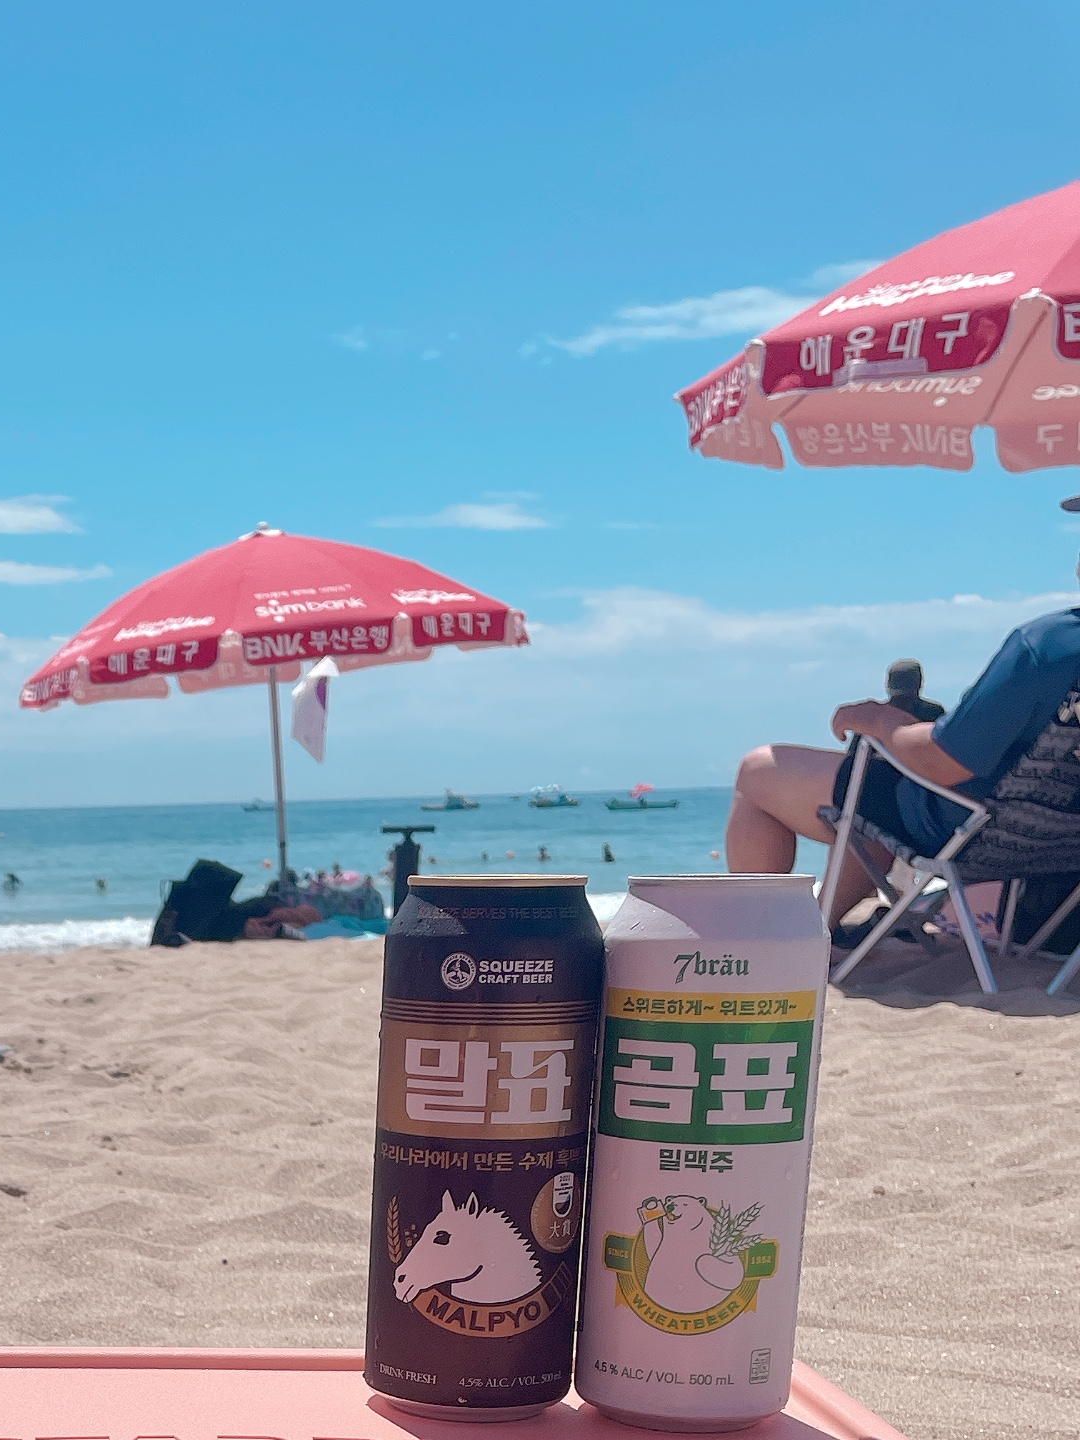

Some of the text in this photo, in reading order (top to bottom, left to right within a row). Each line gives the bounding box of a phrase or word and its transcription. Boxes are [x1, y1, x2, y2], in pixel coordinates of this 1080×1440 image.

[478, 959, 554, 974] SQUEEZE
[478, 973, 553, 984] CRAFT BEER
[673, 950, 750, 984] 7bräu
[404, 1037, 576, 1125] 말표
[612, 1038, 799, 1126] 곰표
[473, 1151, 515, 1172] 만든
[518, 1149, 555, 1171] 수제
[657, 1148, 734, 1174] 밀맥주
[426, 1294, 542, 1333] MALPYO
[632, 1293, 741, 1331] WHEATBEER
[379, 1363, 437, 1385] DRINK FRESH
[689, 1374, 713, 1386] 500
